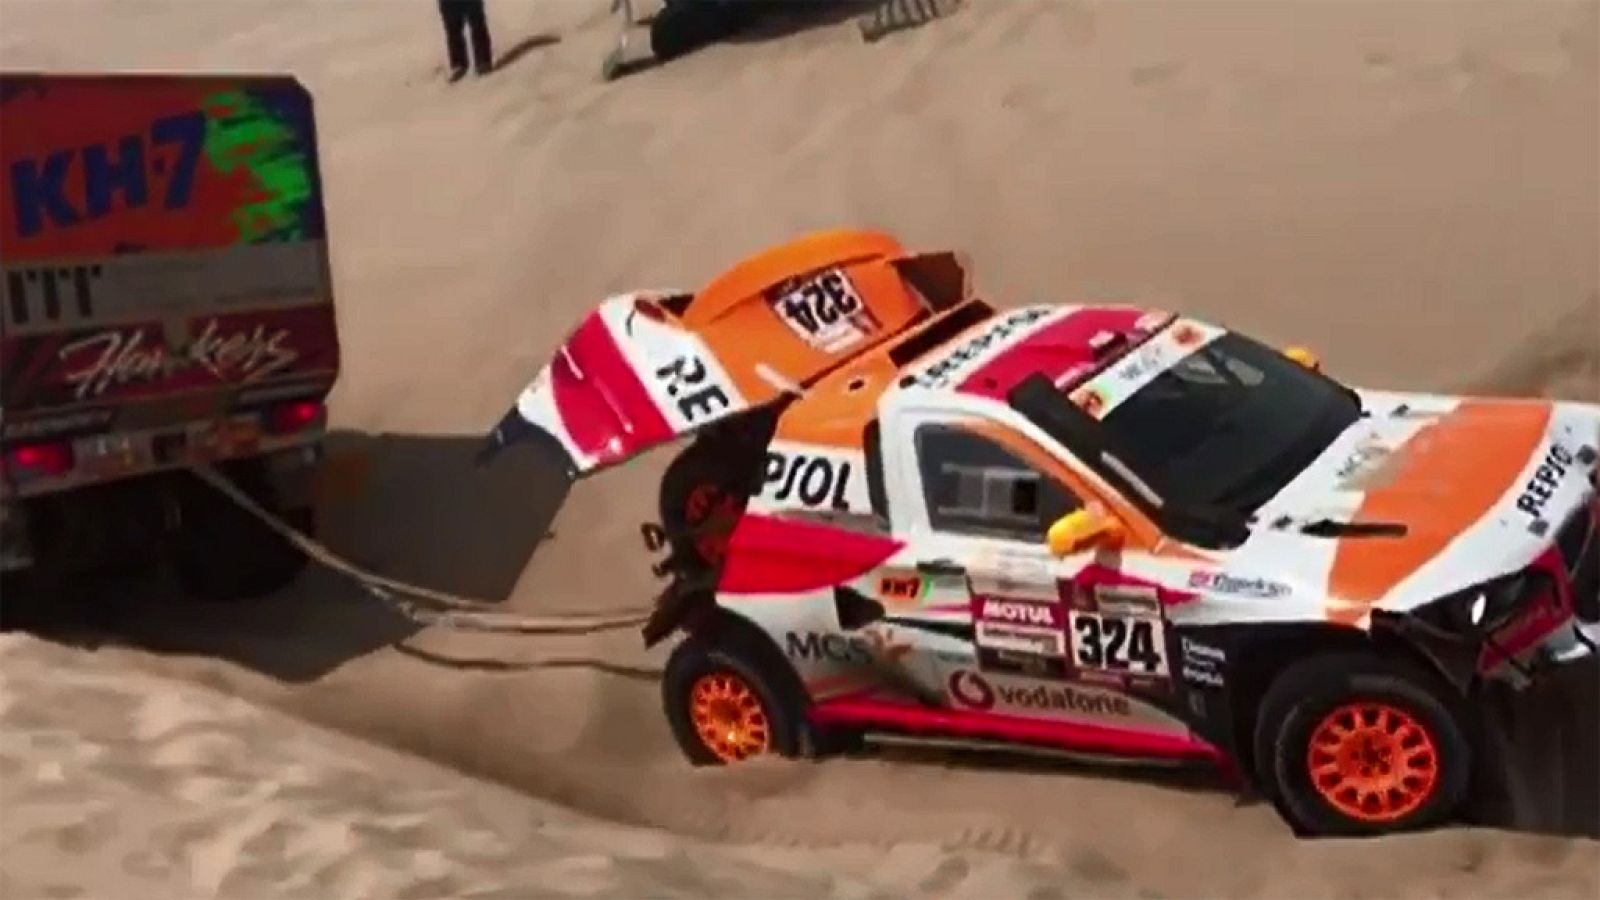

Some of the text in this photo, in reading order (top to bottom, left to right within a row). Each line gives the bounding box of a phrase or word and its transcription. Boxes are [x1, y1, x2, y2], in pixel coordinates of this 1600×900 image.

[785, 273, 858, 334] 324
[983, 600, 1055, 625] MOTUL
[1075, 616, 1162, 673] 324
[997, 683, 1131, 716] vodafone
